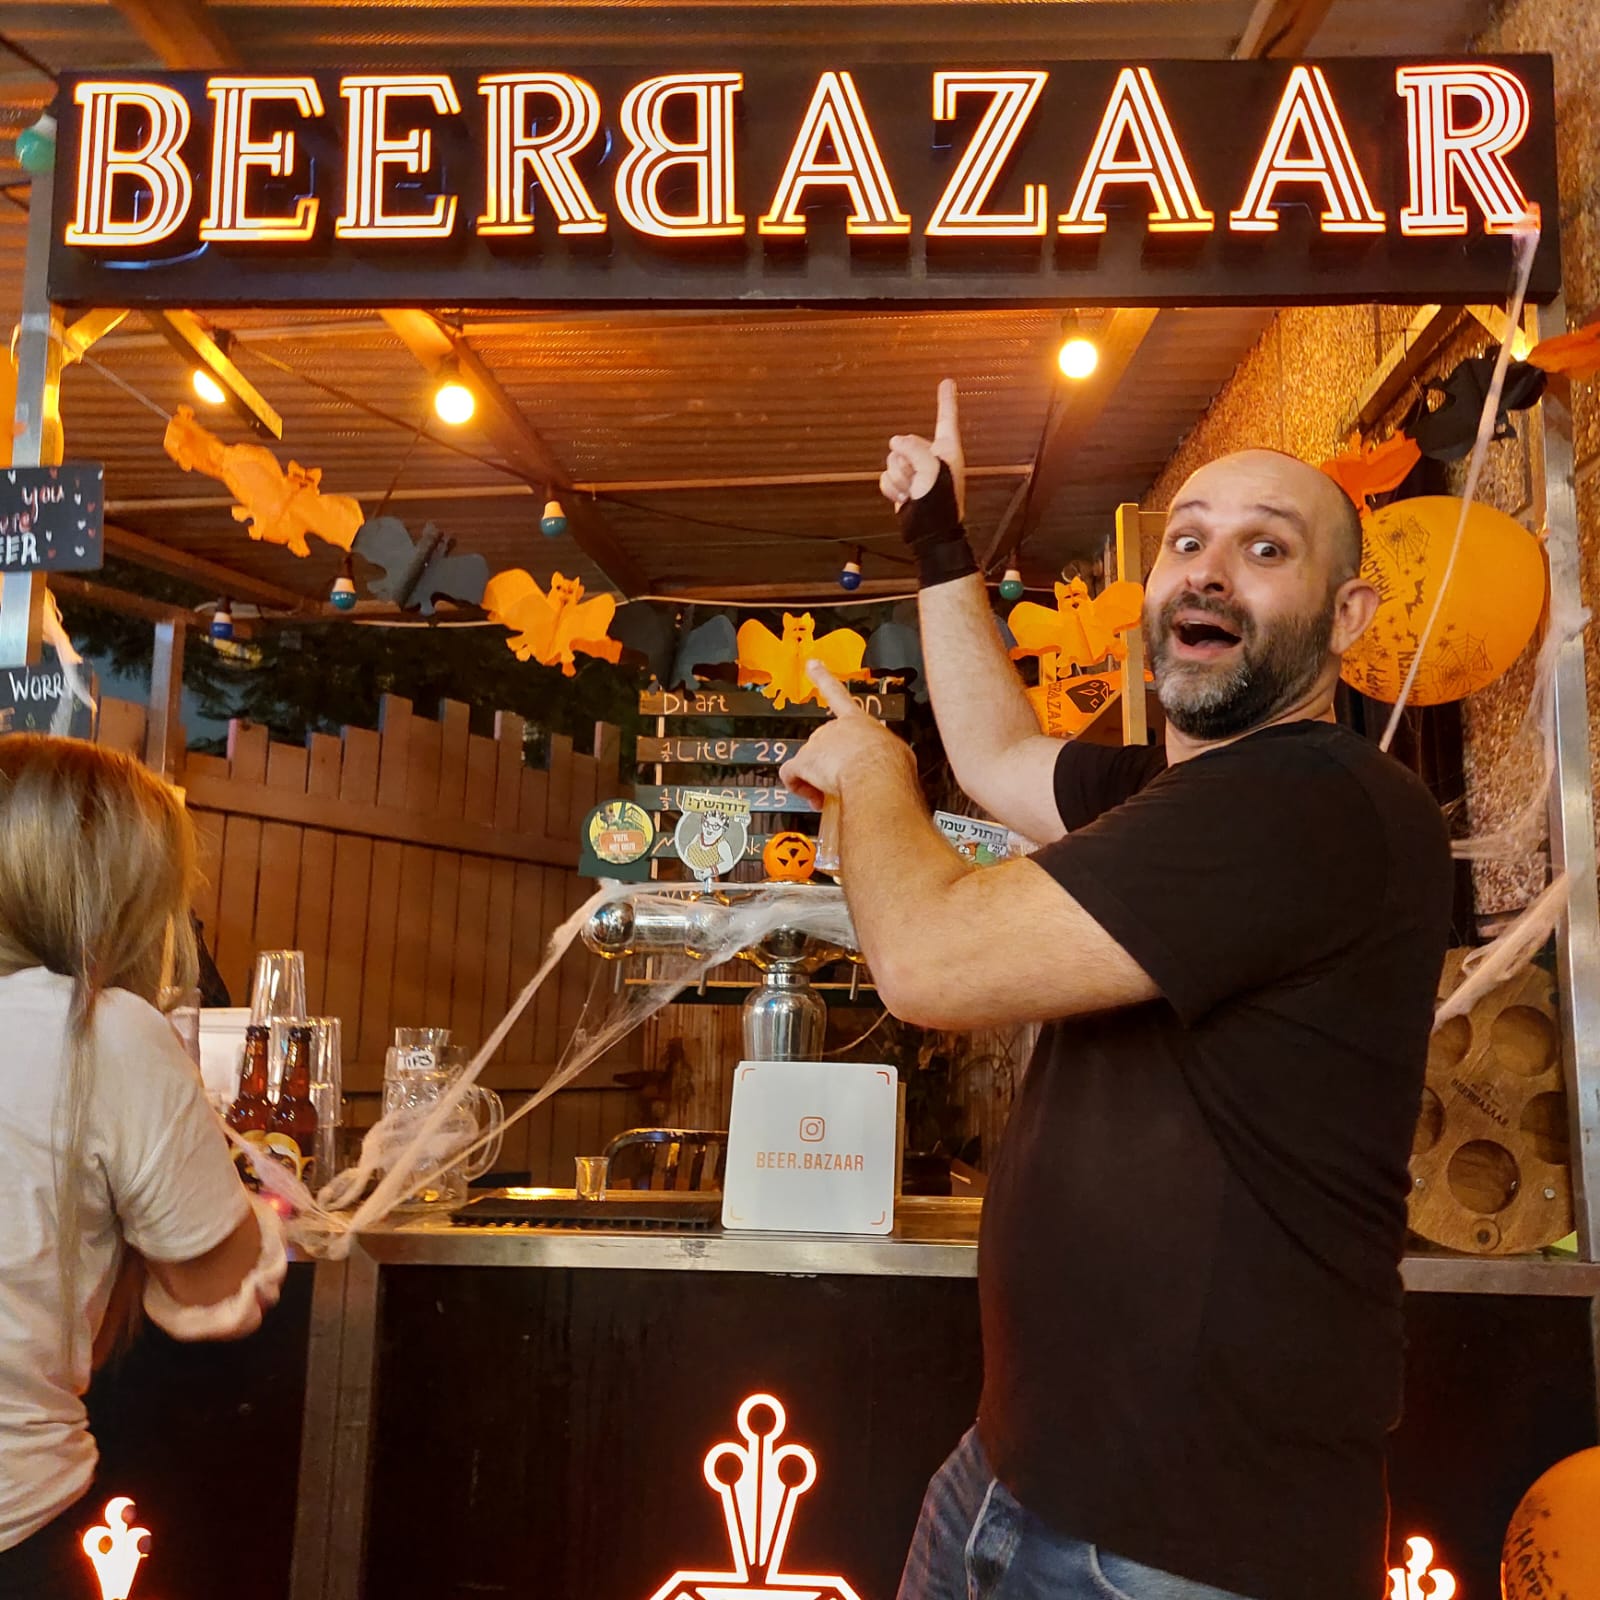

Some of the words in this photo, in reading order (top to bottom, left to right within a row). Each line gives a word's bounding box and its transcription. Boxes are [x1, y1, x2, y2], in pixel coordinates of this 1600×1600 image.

[64, 64, 1543, 247] BEERBAZAAR
[22, 485, 64, 524] you
[0, 532, 38, 566] ER
[676, 740, 741, 763] Liter
[754, 741, 789, 763] 29
[753, 788, 790, 808] 25
[756, 1151, 864, 1172] BEER.BAZAAR
